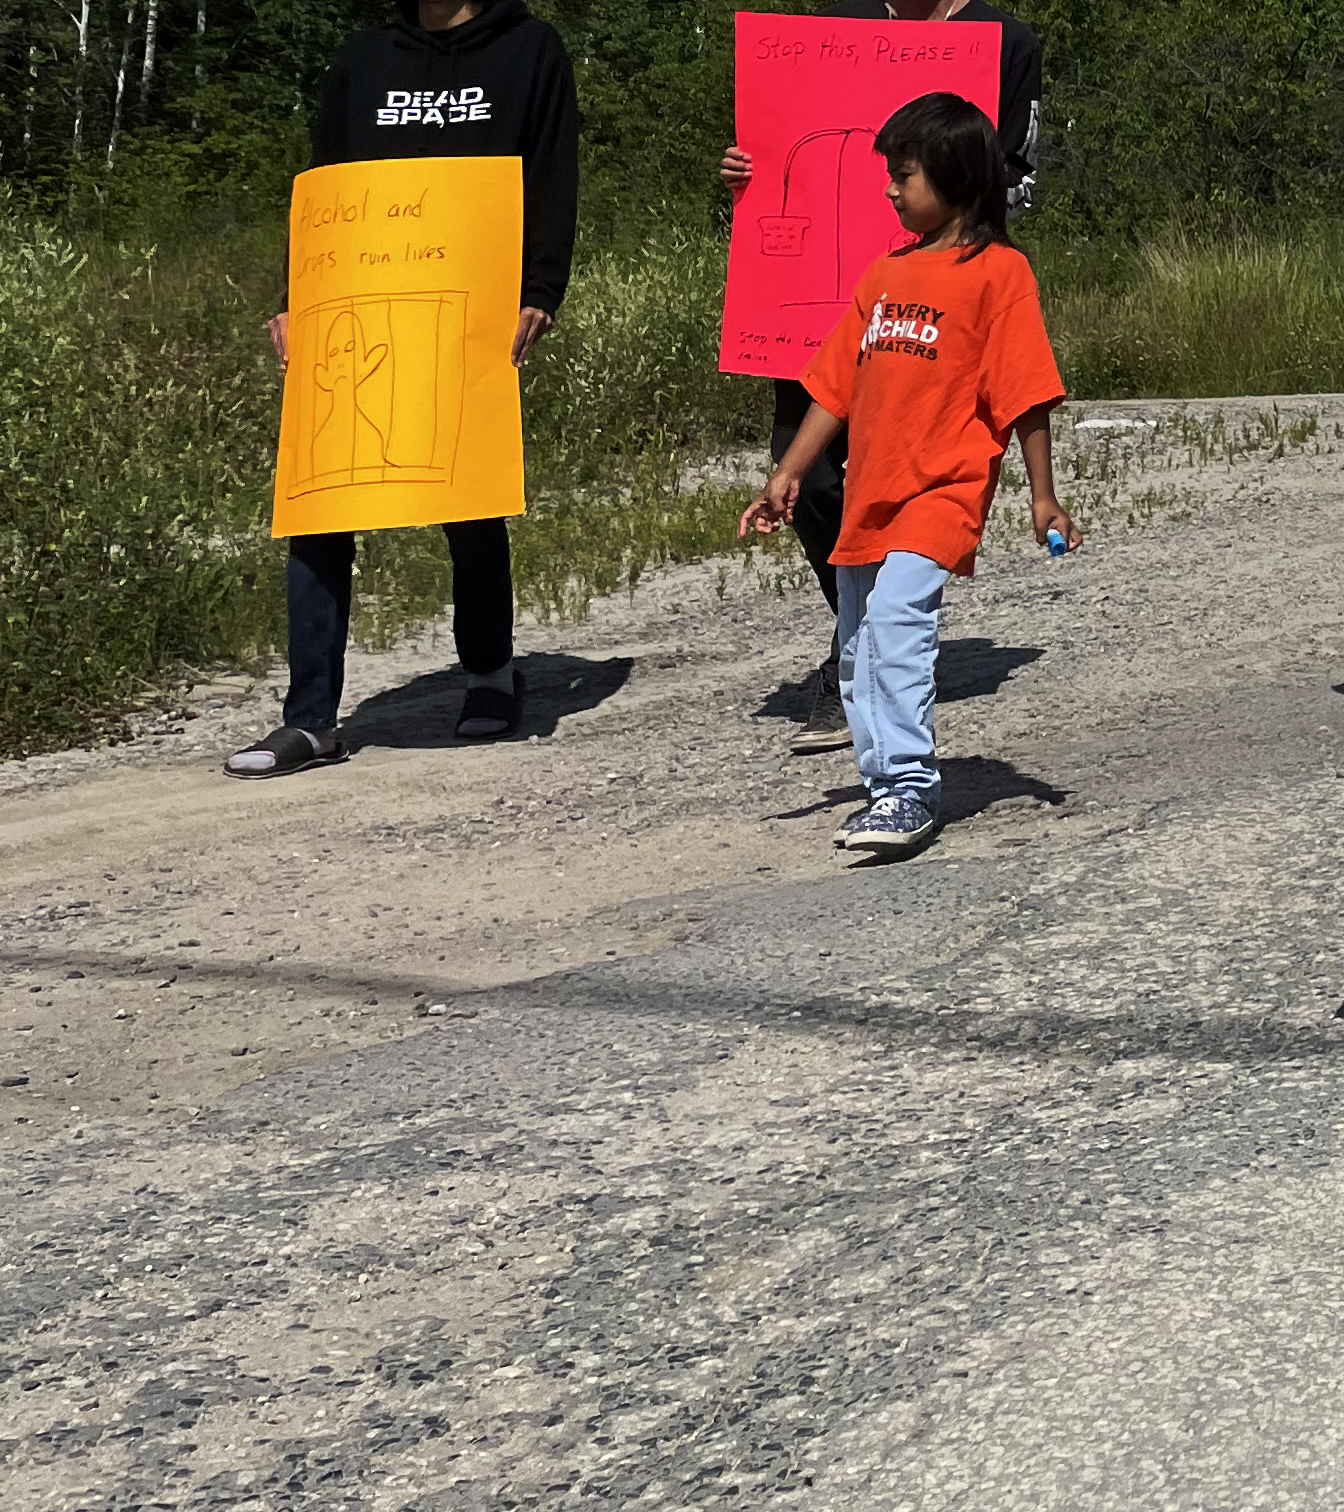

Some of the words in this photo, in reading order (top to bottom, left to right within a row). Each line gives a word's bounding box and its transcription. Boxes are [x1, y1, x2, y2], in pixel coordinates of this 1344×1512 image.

[873, 35, 957, 64] PLEASE
[386, 86, 484, 108] DEAD
[376, 102, 492, 129] SPACE
[299, 187, 371, 232] Alcohol
[386, 187, 430, 219] and
[359, 251, 393, 266] ruin
[404, 241, 447, 262] lives
[884, 303, 946, 324] EVERY
[879, 319, 940, 344] CHILD
